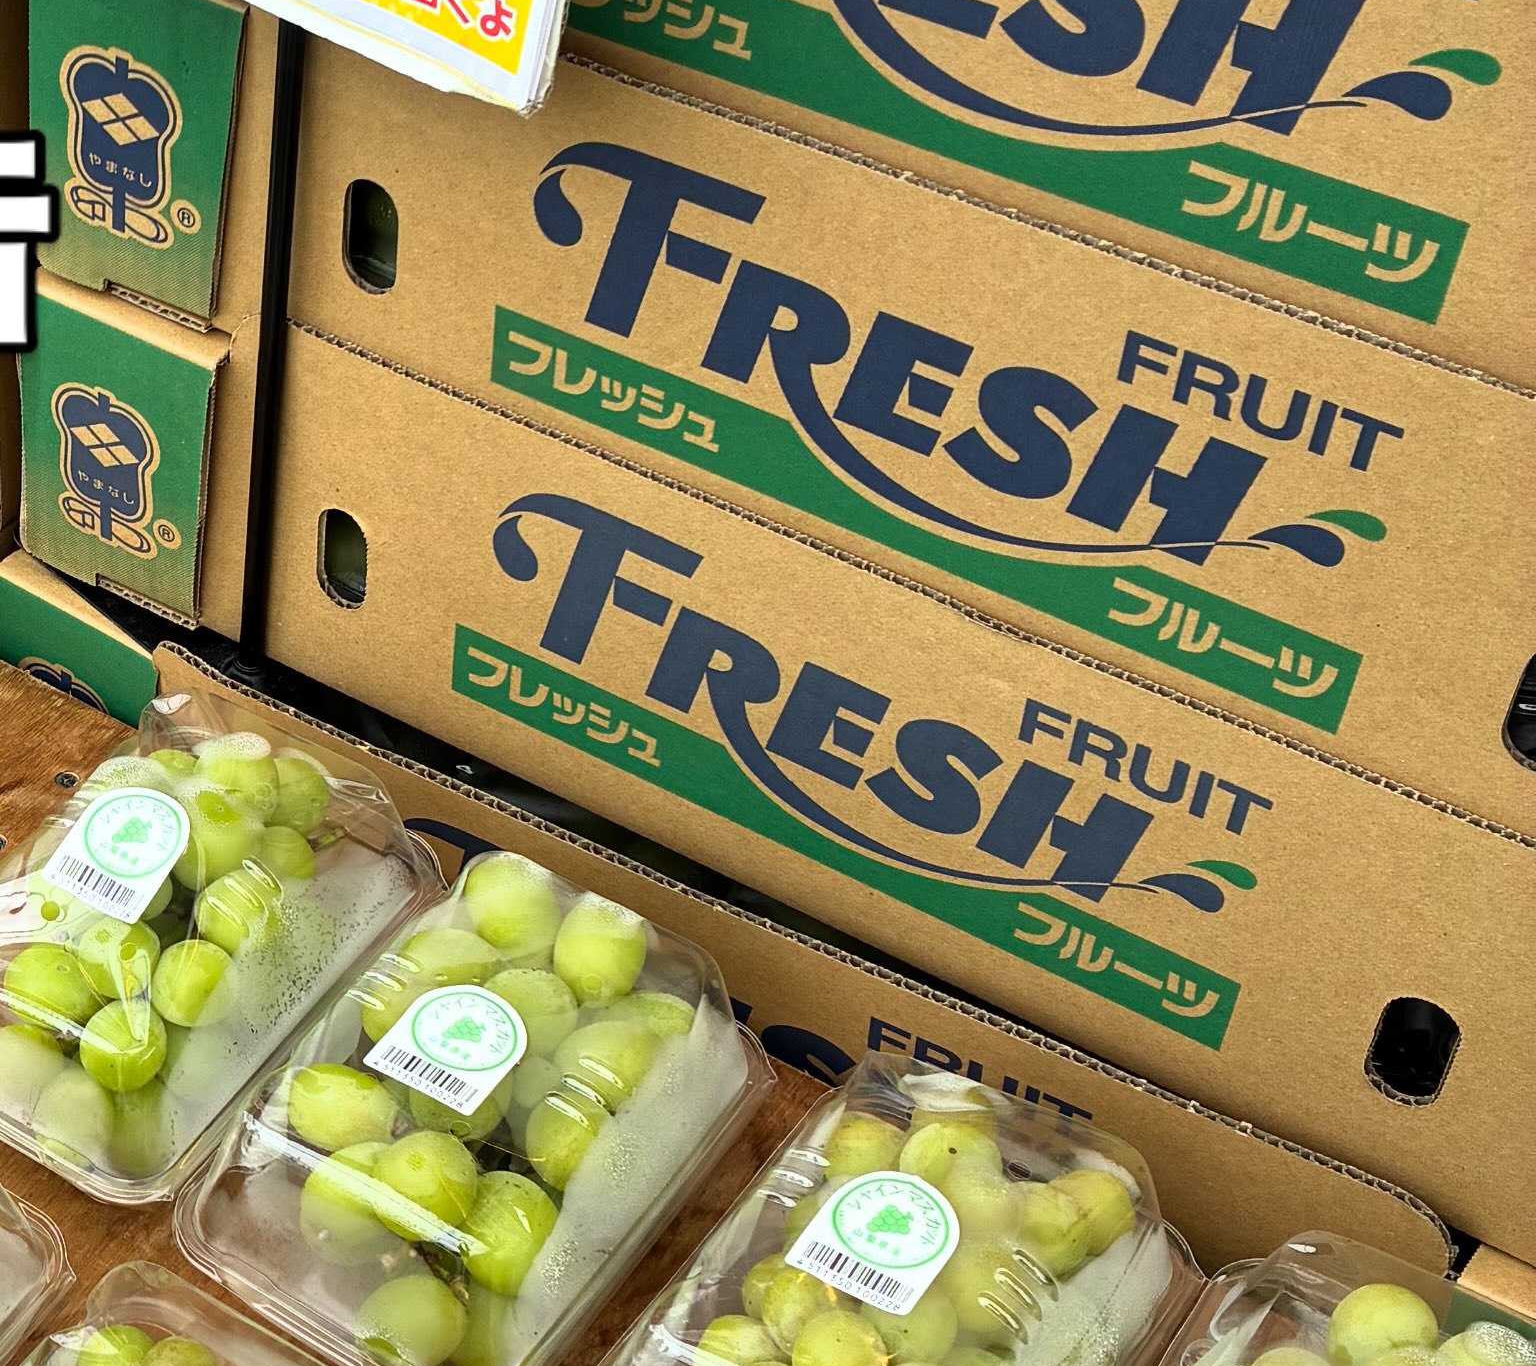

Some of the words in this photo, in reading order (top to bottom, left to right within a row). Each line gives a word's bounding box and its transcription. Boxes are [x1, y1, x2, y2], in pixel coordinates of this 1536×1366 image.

[88, 151, 152, 188] やまなし
[1181, 160, 1441, 285] フルーツ
[505, 331, 722, 455] フレッシュ
[533, 141, 1269, 567] FRESH
[1116, 329, 1404, 474] FRUIT
[77, 469, 135, 505] やまなし
[493, 492, 1155, 903] FRESH
[1107, 578, 1339, 700] フルーツ
[465, 645, 663, 768] フレッシュ
[1017, 698, 1274, 838] FRUIT
[1012, 900, 1222, 1022] フルーツ
[425, 995, 515, 1053] シャインマスカット
[844, 1186, 940, 1248] シャインマスカット
